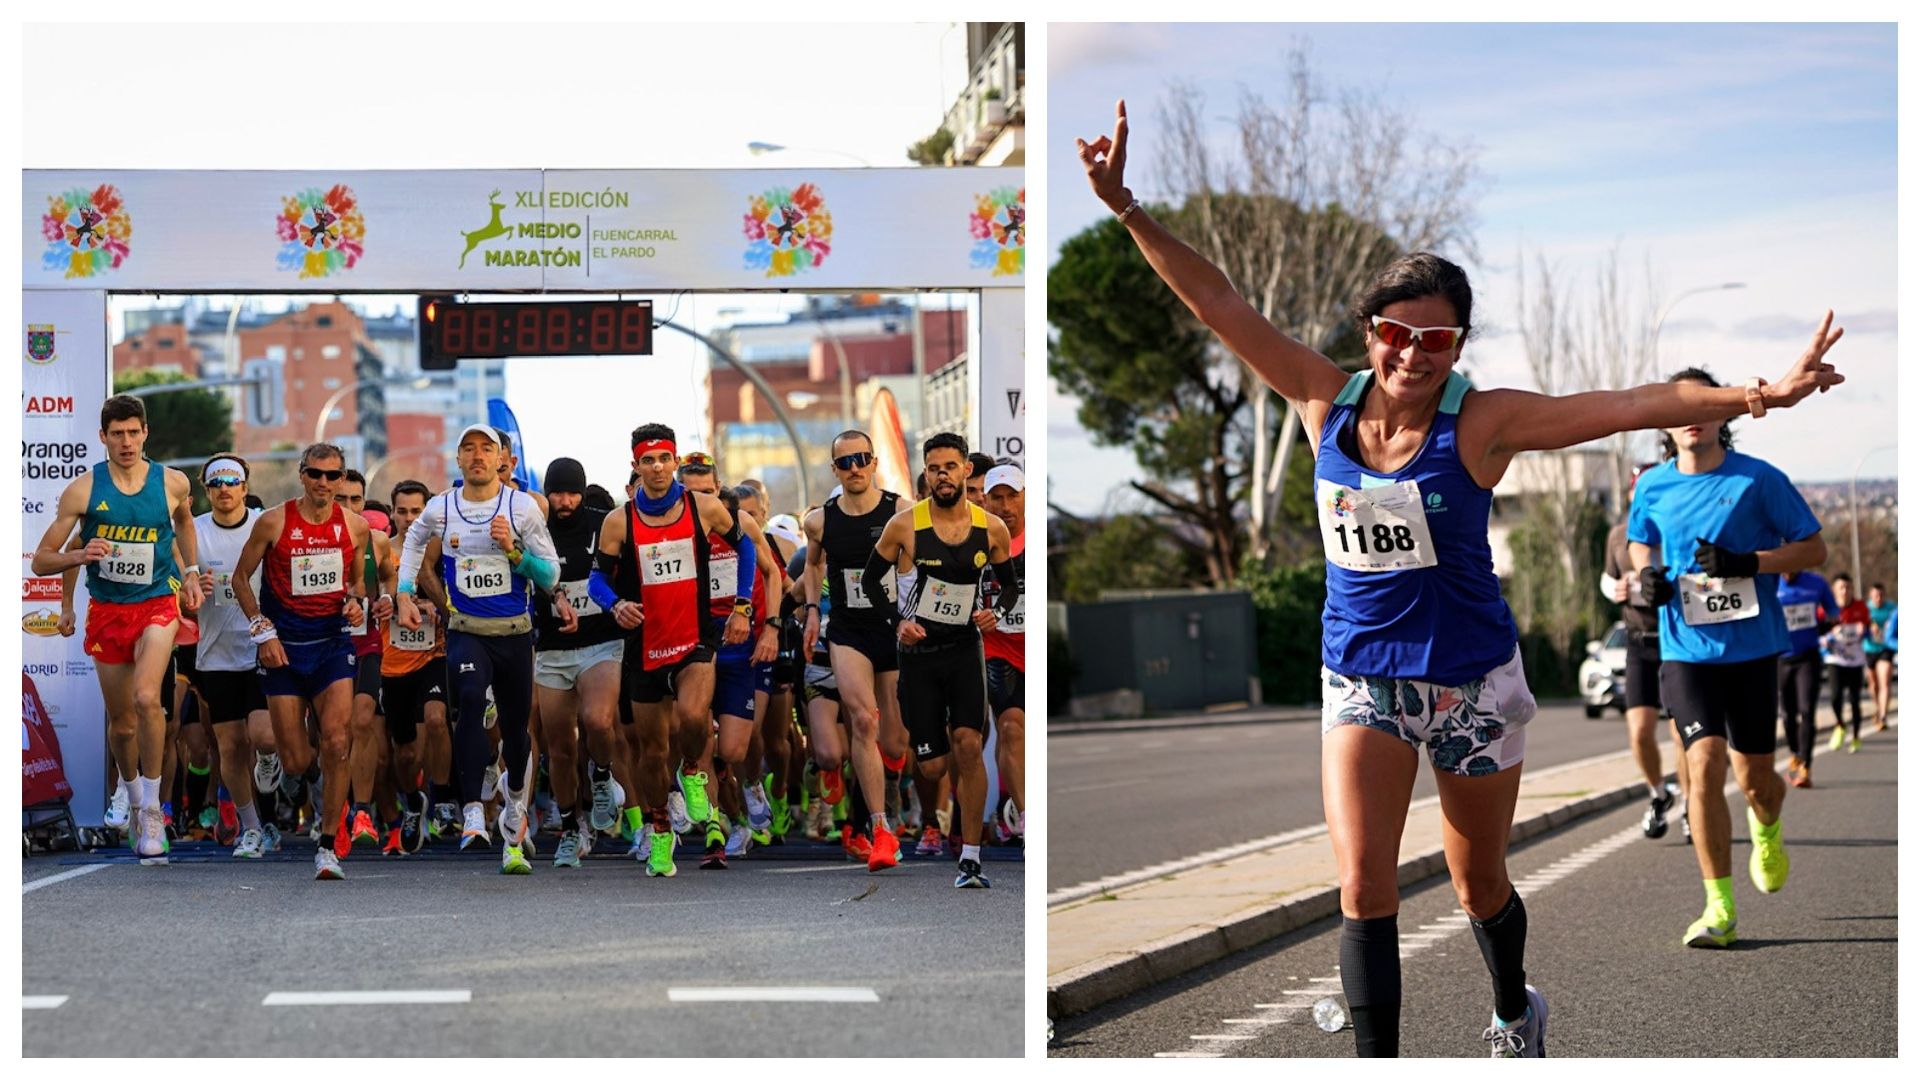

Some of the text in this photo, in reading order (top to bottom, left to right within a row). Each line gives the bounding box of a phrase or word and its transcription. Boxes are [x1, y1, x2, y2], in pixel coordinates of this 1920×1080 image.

[515, 187, 628, 208] XLI EDICIÓN
[518, 223, 581, 238] MEDIO
[593, 230, 677, 241] FUENCARRAL
[485, 246, 581, 267] MARATÓN
[593, 247, 656, 258] EL PARDO
[26, 396, 73, 413] ADM
[996, 437, 1025, 456] l'O
[27, 461, 87, 480] bleue
[96, 524, 158, 543] BIKILA
[1335, 523, 1415, 554] 1188
[107, 561, 146, 576] 1828
[654, 559, 682, 576] 317
[301, 571, 336, 586] 1938
[464, 573, 503, 589] 1063
[933, 601, 961, 616] 153
[1706, 593, 1742, 612] 626
[1005, 612, 1025, 626] 66
[400, 631, 425, 642] 538
